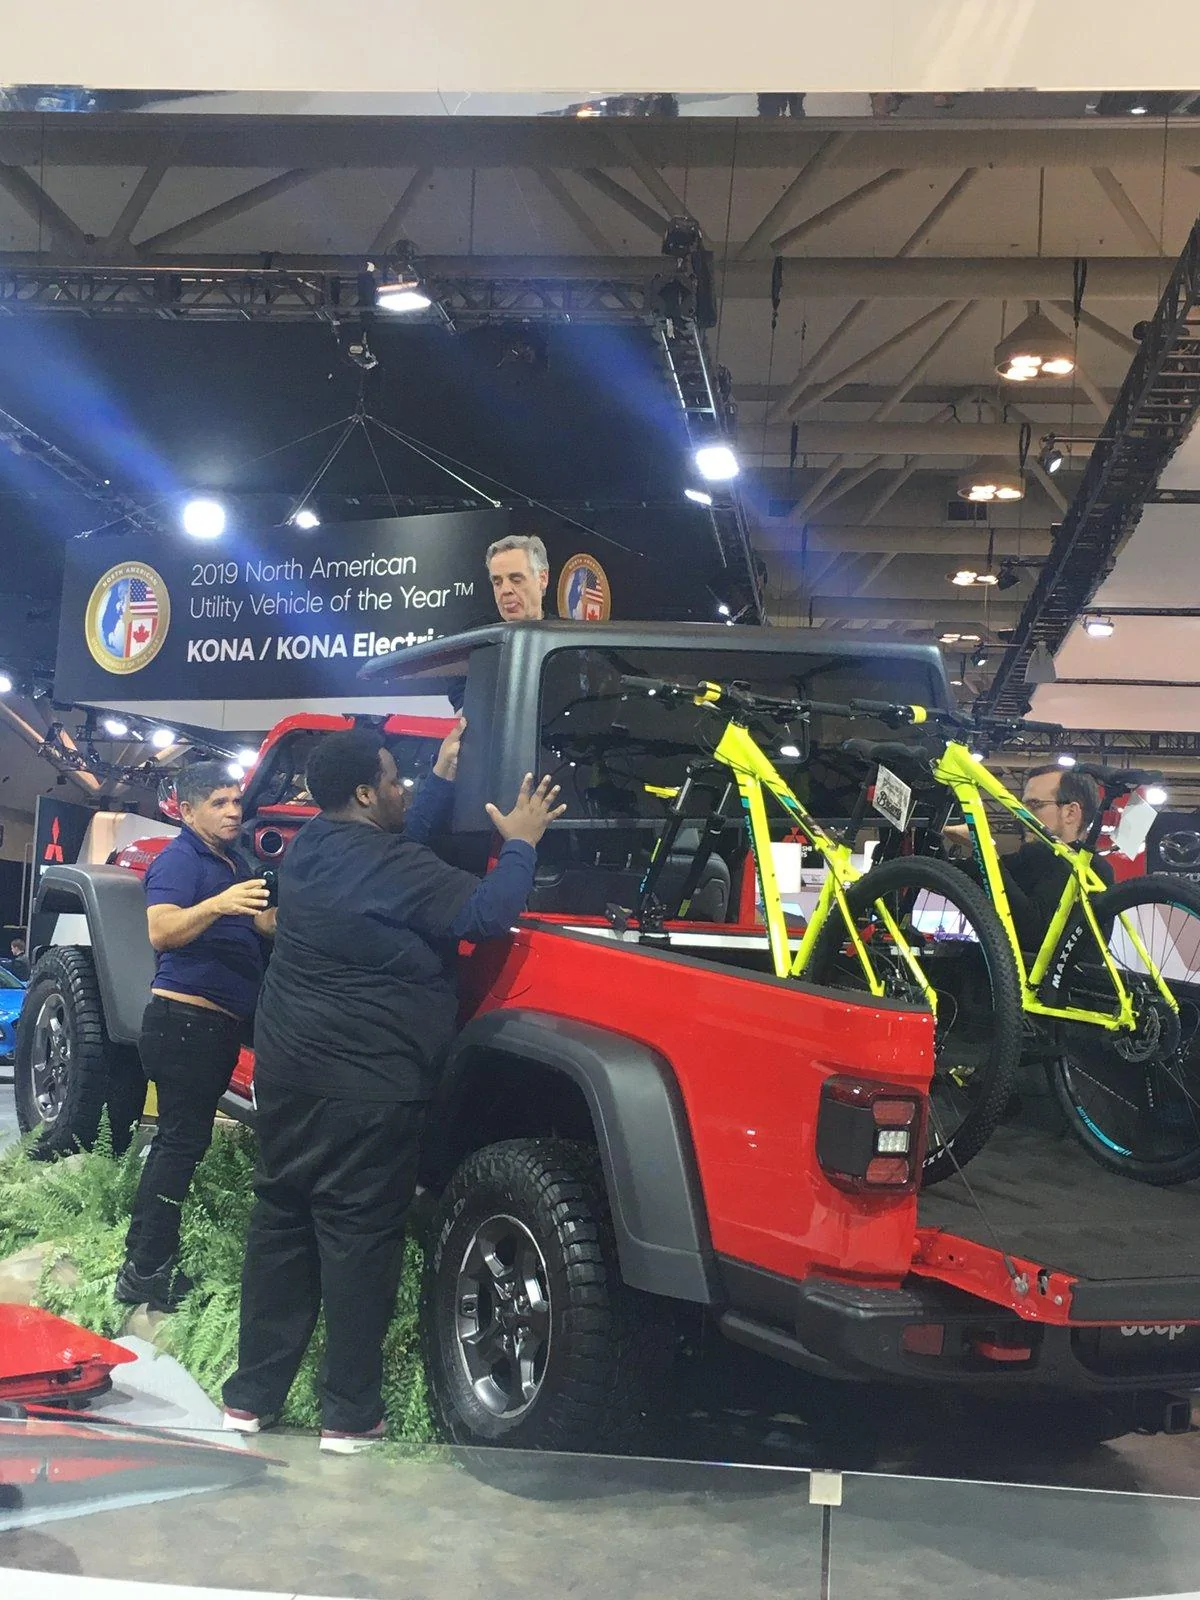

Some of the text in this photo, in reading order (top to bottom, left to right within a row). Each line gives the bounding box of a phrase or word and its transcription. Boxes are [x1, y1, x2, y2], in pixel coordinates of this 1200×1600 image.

[191, 553, 416, 586] 2019 North American
[190, 595, 244, 622] Utility
[250, 591, 323, 616] Vehicle
[330, 588, 351, 612] of
[358, 587, 392, 611] the
[187, 637, 255, 663] KONA
[259, 637, 272, 661] /
[276, 634, 348, 660] KONA
[353, 627, 445, 657] Electri
[1052, 926, 1083, 989] MAXXIS
